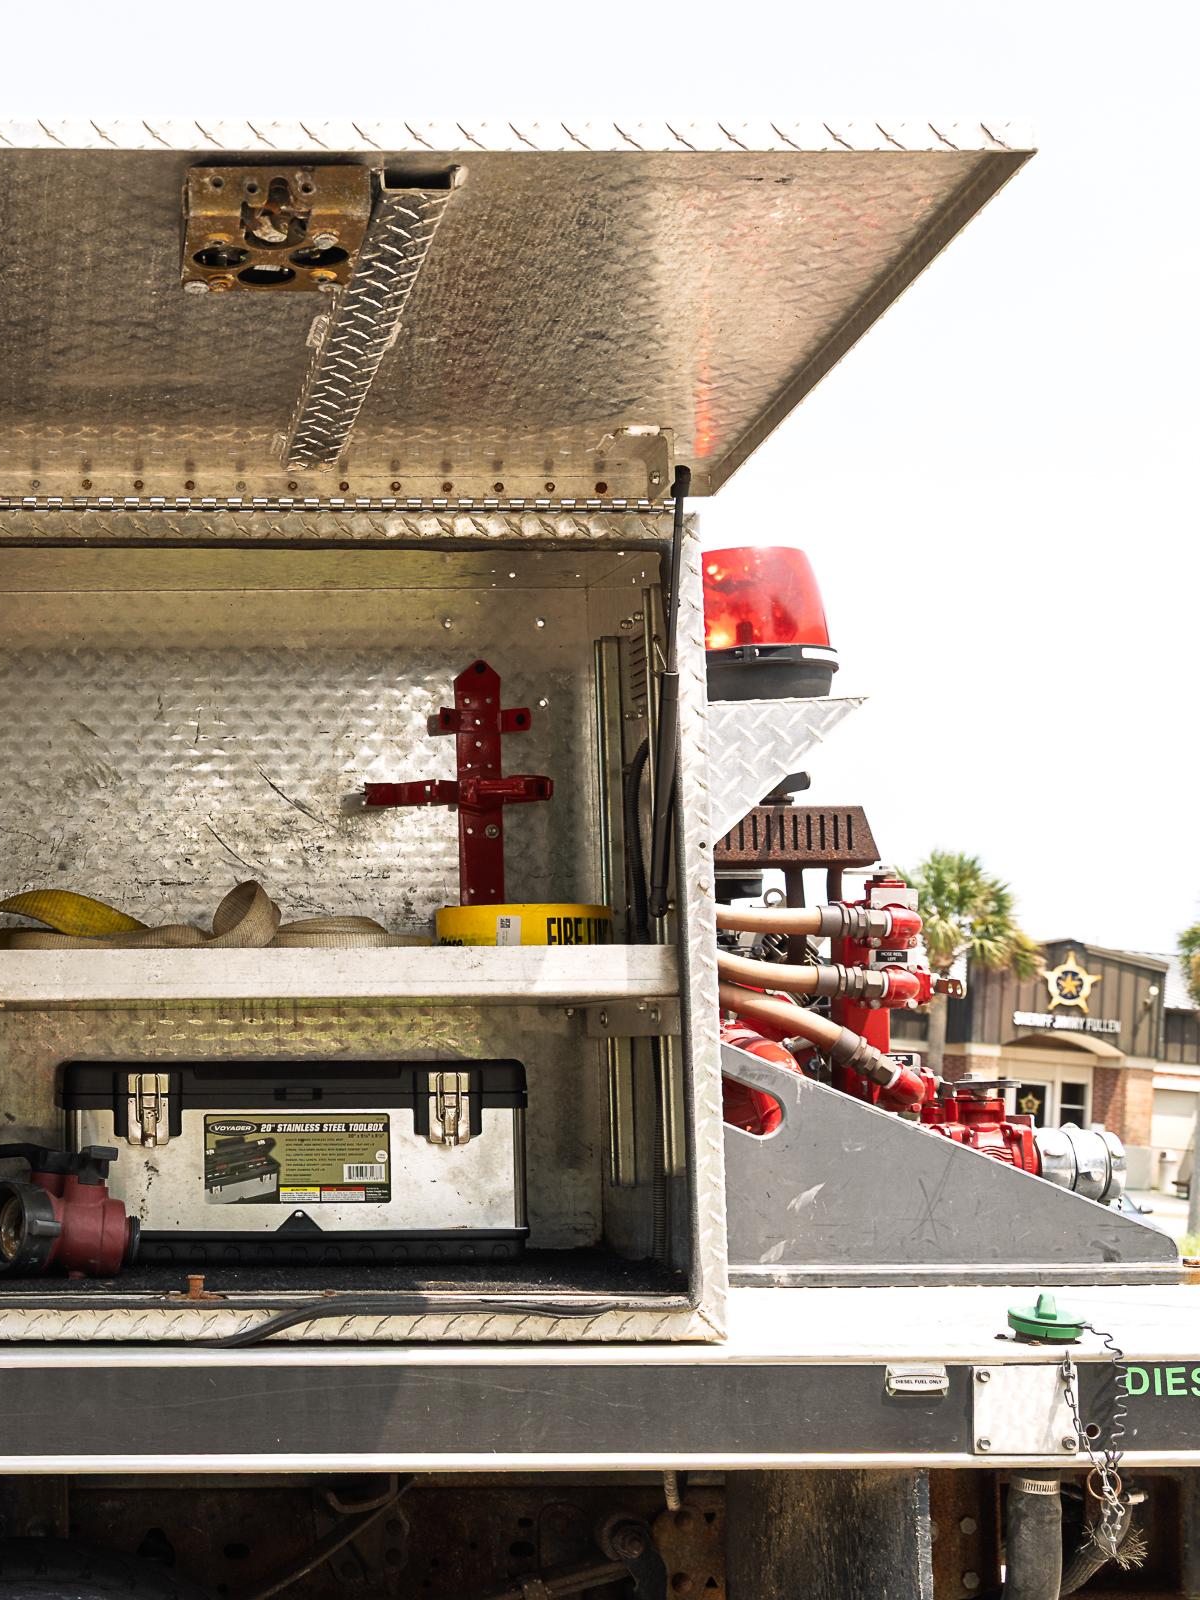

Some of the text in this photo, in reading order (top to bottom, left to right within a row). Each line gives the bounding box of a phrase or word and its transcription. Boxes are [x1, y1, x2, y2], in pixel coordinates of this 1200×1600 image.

[546, 917, 584, 945] FIRE
[276, 1123, 320, 1132] STAINLESS
[322, 1123, 346, 1132] STEEL
[348, 1123, 384, 1131] TOOLBOX
